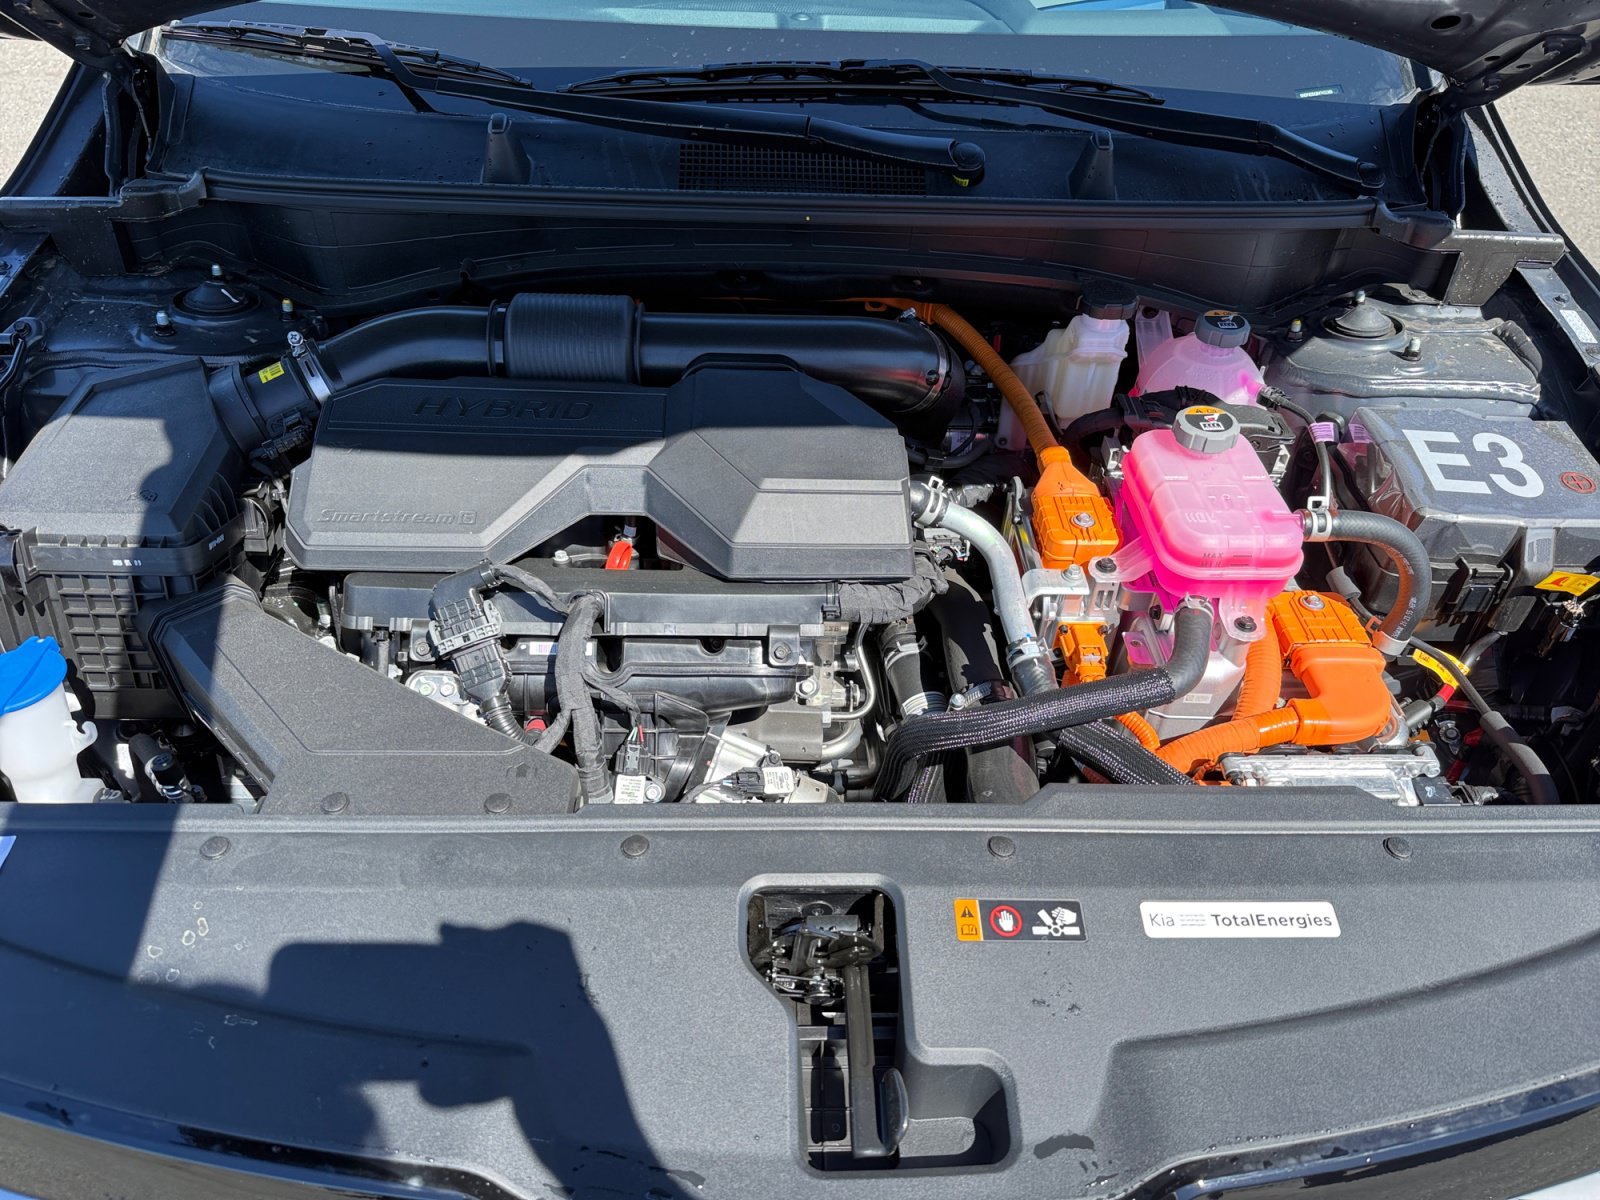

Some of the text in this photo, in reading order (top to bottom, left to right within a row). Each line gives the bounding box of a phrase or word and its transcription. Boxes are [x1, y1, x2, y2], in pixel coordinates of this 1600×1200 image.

[413, 396, 594, 421] HYBRID
[1402, 429, 1544, 497] E3
[316, 508, 455, 525] Smartstream
[1149, 913, 1175, 927] Kia
[1210, 913, 1333, 929] TotalEnergies
